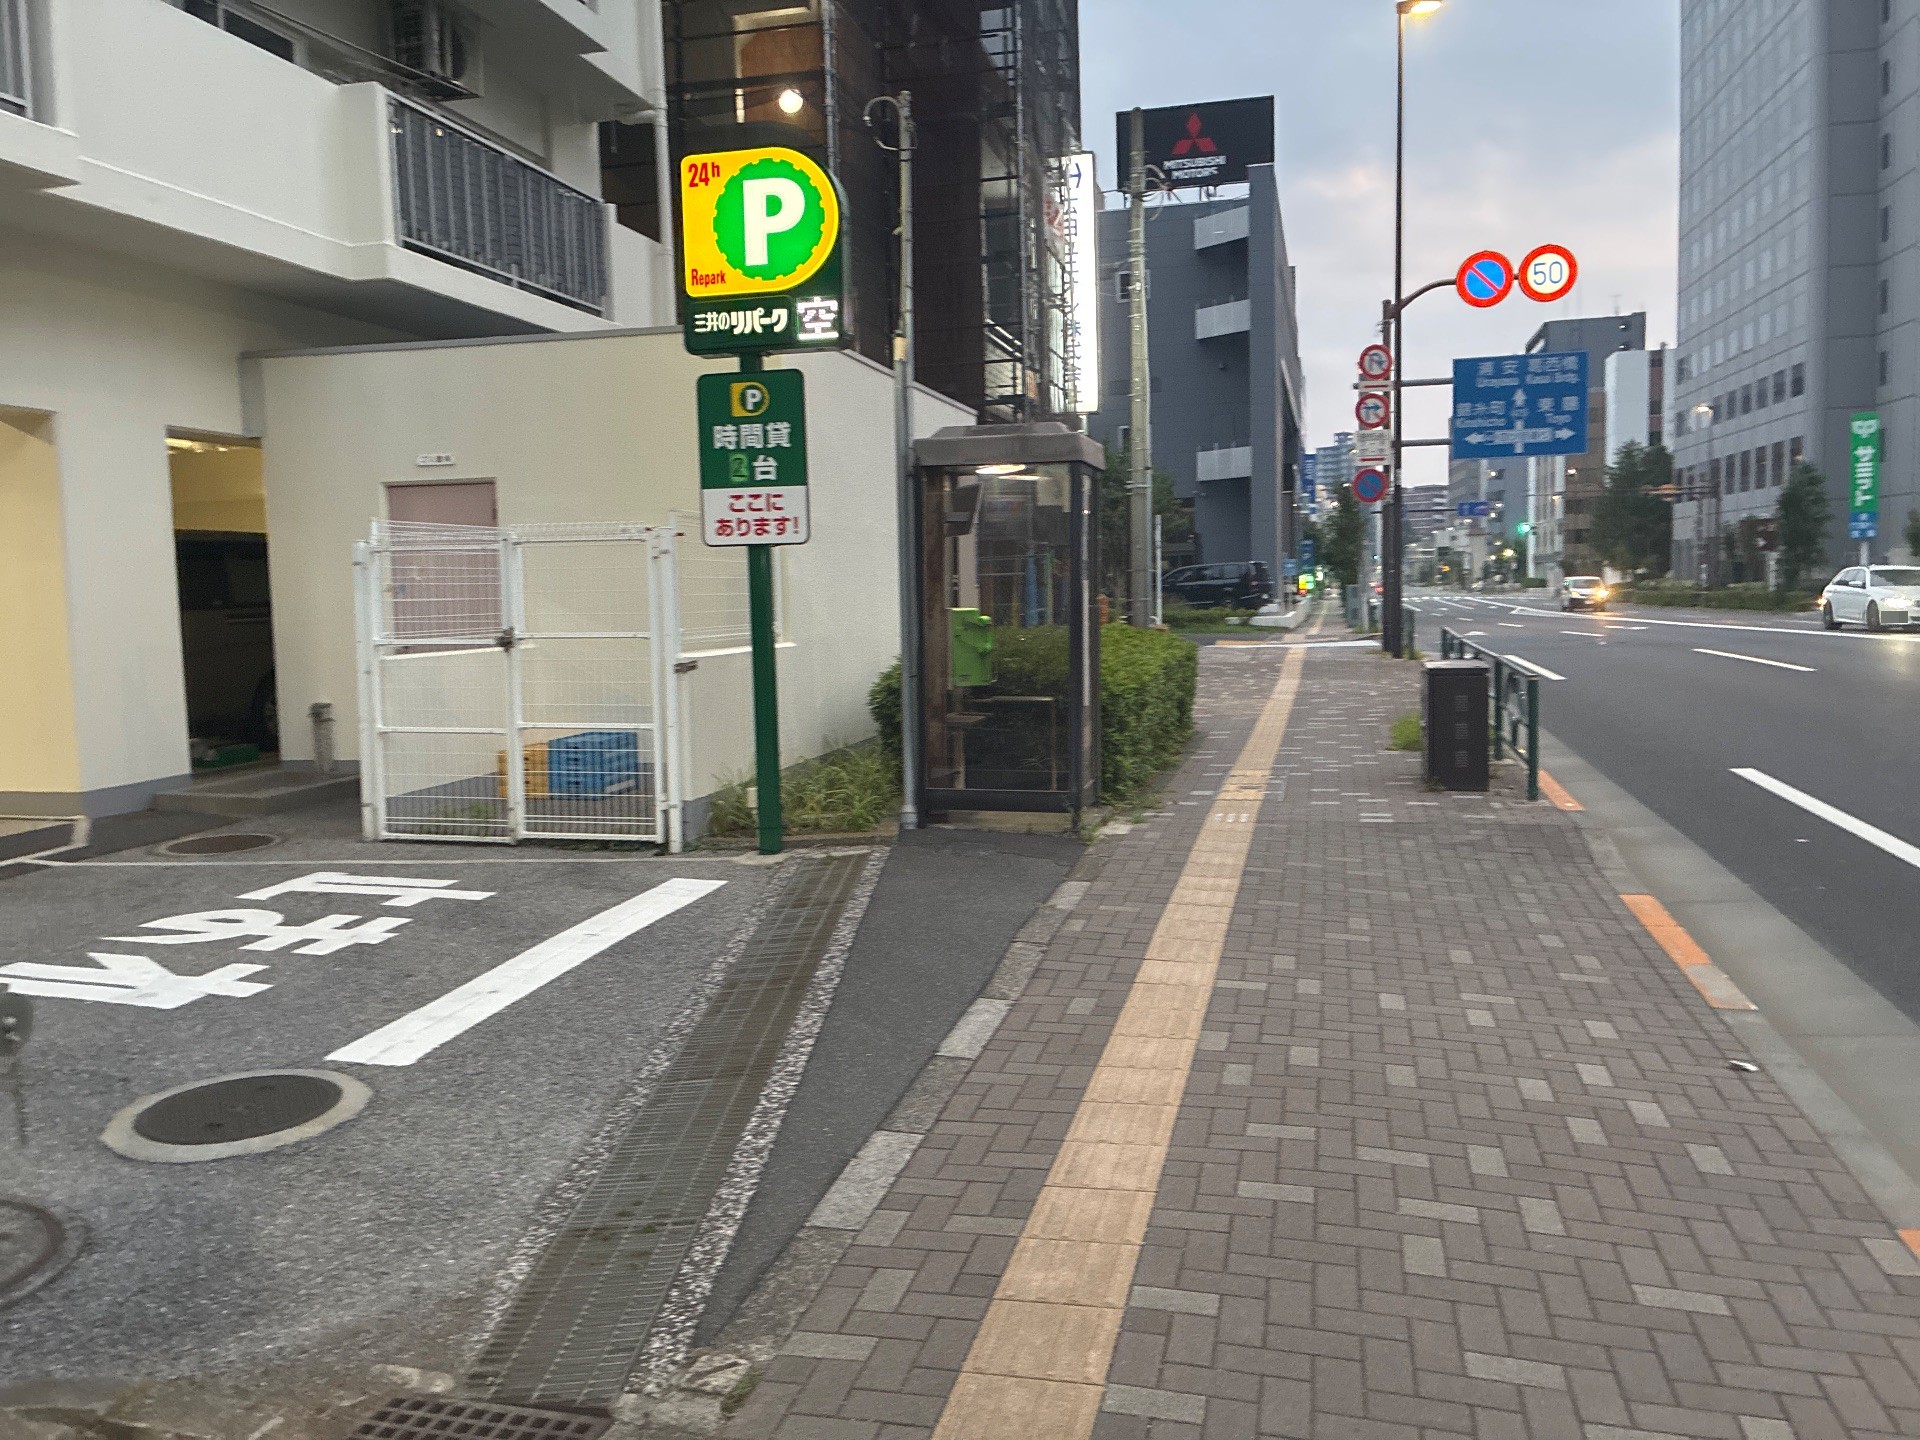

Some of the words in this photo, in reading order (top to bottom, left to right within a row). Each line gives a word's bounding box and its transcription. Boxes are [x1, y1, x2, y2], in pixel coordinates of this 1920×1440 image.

[688, 162, 720, 188] 24h
[743, 177, 805, 266] P
[691, 269, 726, 288] Repark
[1532, 261, 1563, 286] 50
[694, 308, 788, 335] 三井のリパーク
[797, 297, 839, 340] 空
[745, 389, 762, 411] P
[712, 422, 792, 450] 時間貸
[728, 493, 784, 513] ここに
[0, 871, 497, 1010] 止まれ
